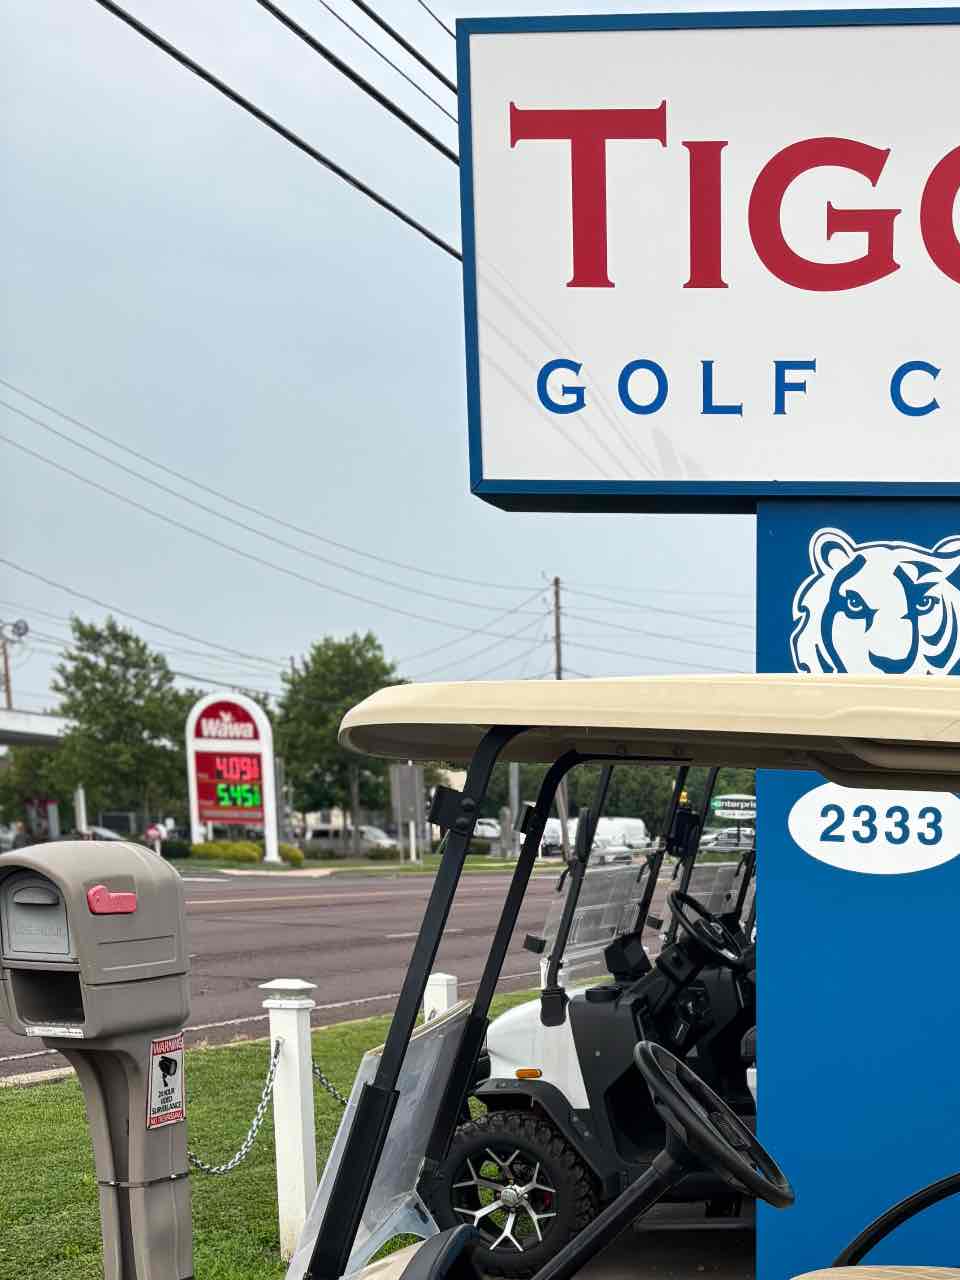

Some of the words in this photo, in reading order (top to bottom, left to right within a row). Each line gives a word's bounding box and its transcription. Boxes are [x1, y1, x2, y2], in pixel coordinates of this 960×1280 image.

[536, 357, 817, 416] GOLF
[201, 716, 254, 738] Wawa
[819, 803, 943, 846] 2333
